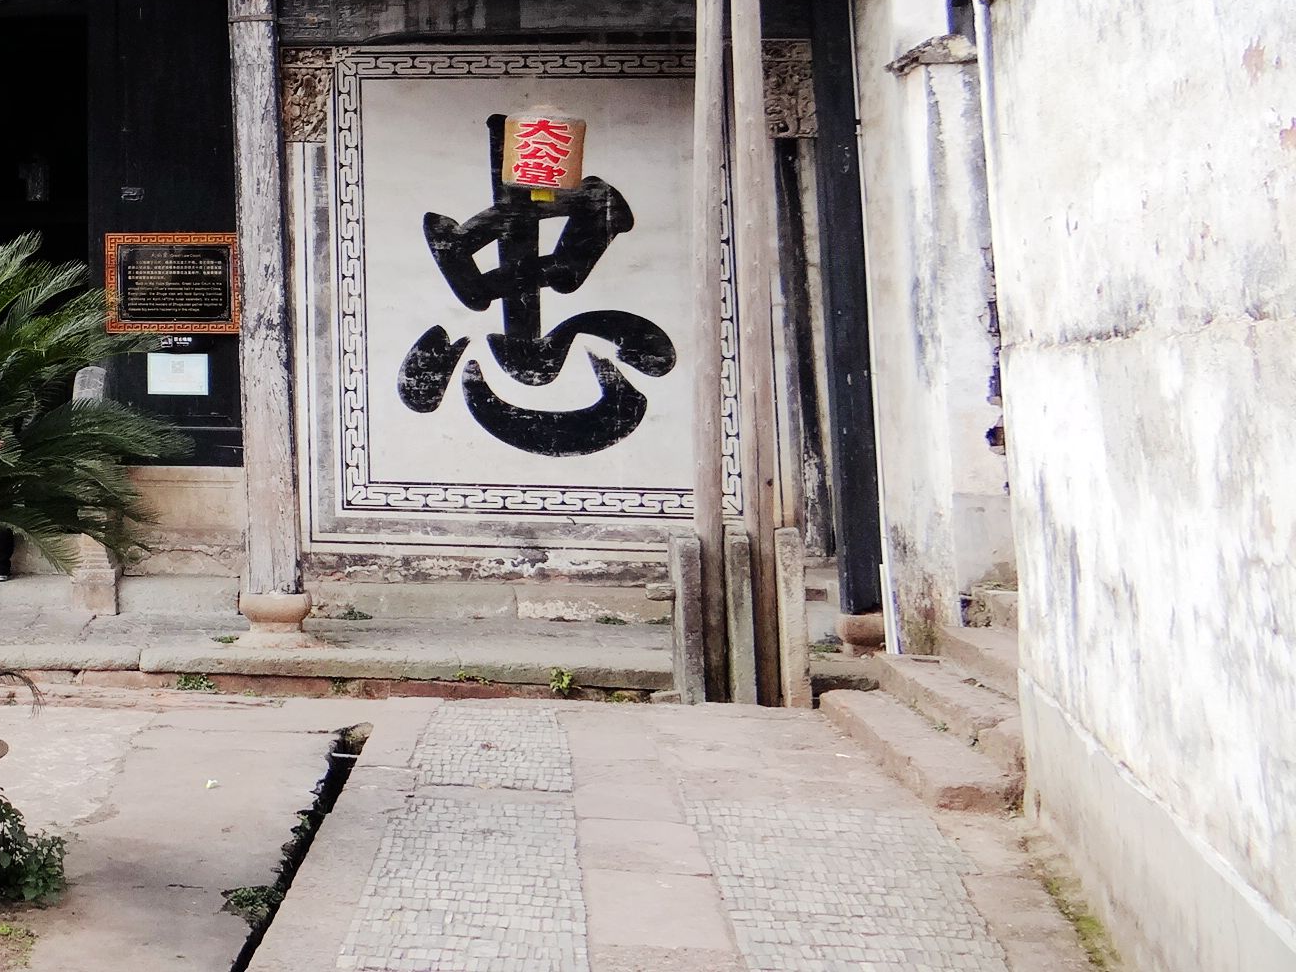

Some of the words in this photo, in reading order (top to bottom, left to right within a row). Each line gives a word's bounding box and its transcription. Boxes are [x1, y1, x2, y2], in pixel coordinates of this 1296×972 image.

[513, 118, 574, 188] 大公堂
[397, 113, 677, 458] 忠
